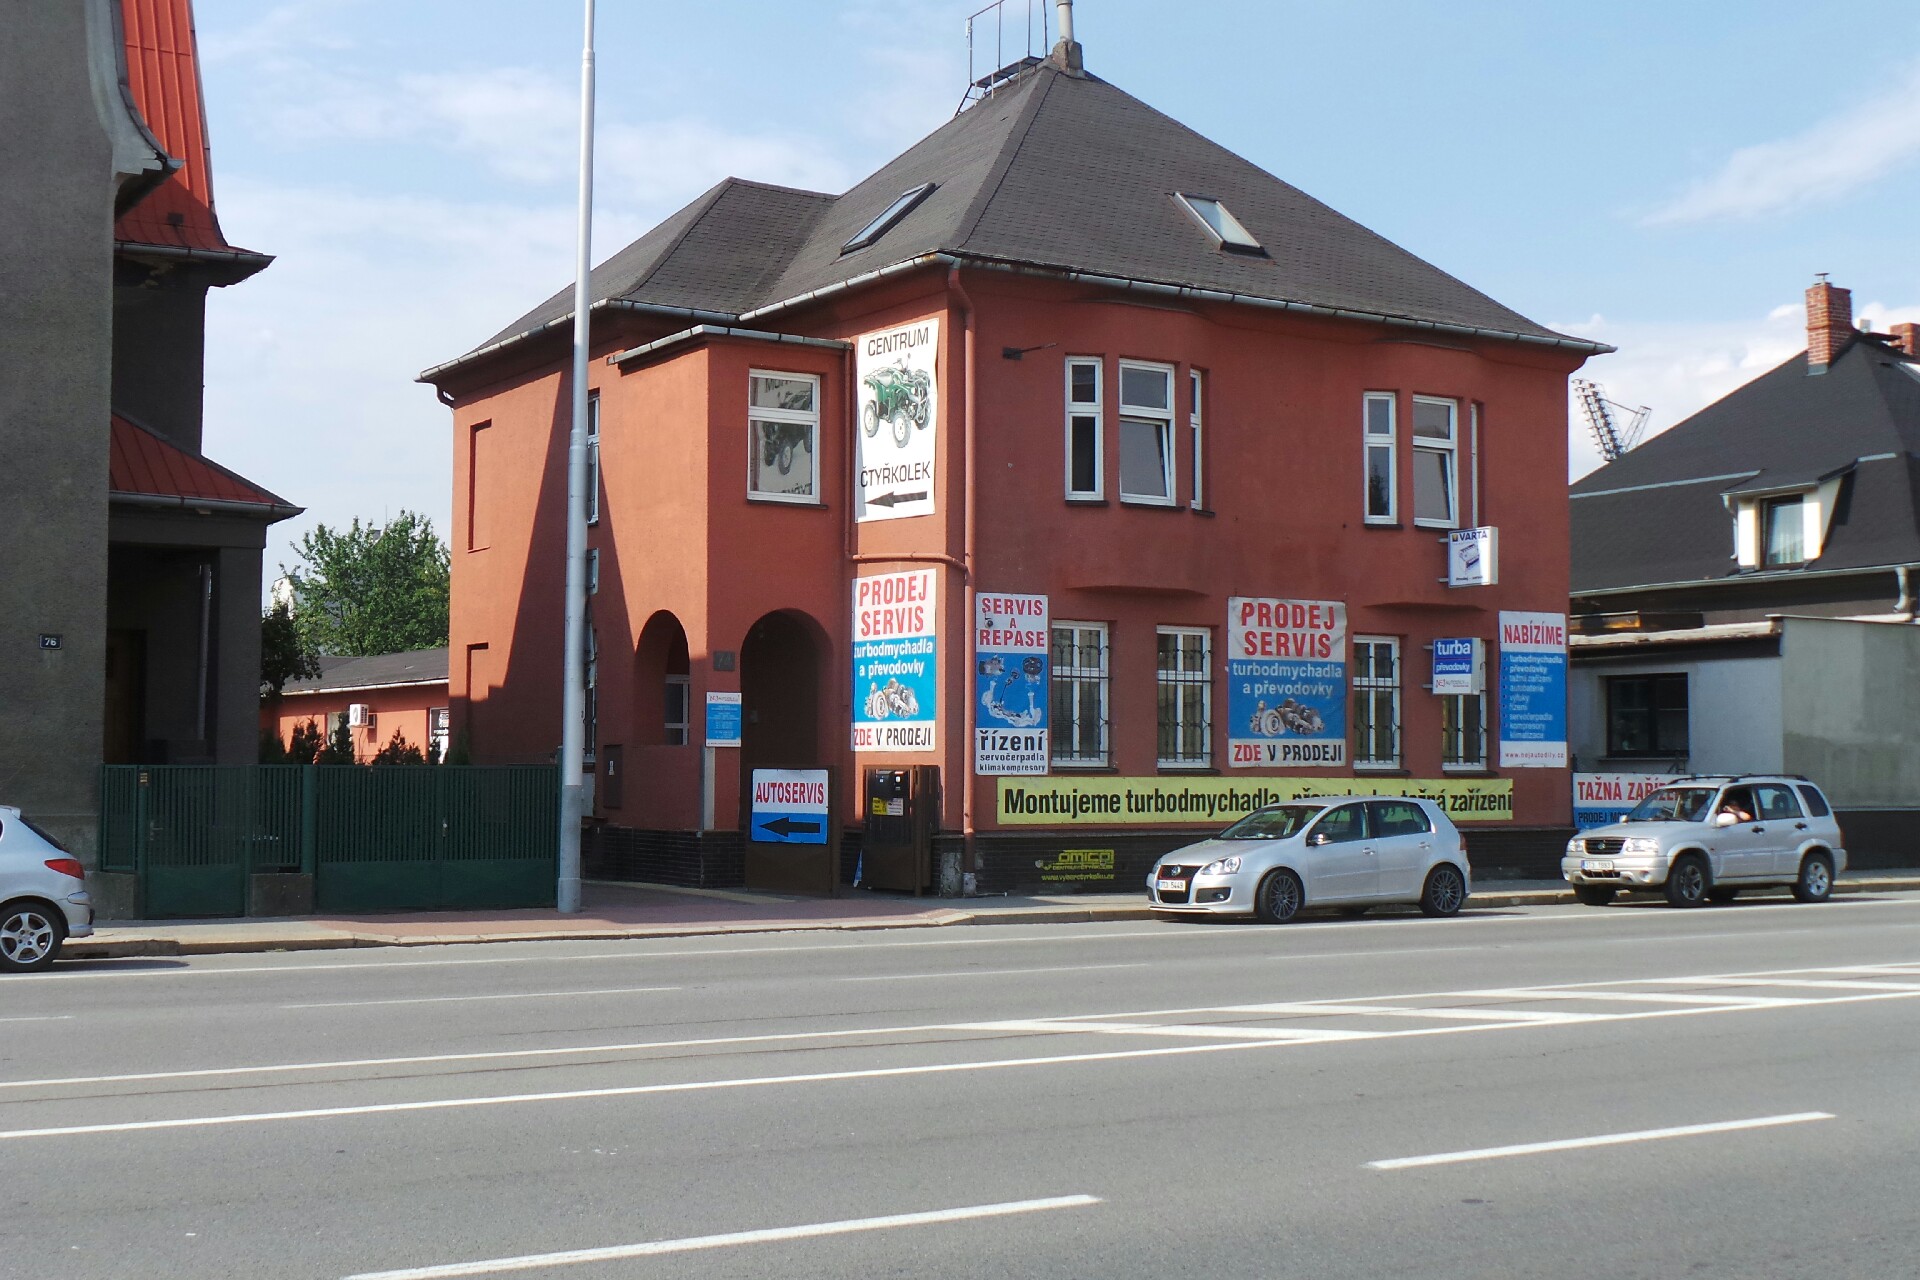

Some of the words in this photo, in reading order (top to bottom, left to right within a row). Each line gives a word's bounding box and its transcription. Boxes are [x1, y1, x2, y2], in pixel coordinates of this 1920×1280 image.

[867, 327, 929, 357] CENTRUM
[860, 461, 931, 488] ČTYŘKOLEK
[1459, 531, 1487, 541] VARTA
[859, 574, 928, 607] PRODEJ
[981, 598, 1043, 616] SERVIS
[1241, 602, 1335, 630] PRODEJ
[860, 605, 924, 637] SERVIS
[1009, 617, 1017, 629] A
[44, 637, 57, 646] 76
[979, 629, 1045, 648] REPASE
[1504, 620, 1563, 646] NABÍZÍME
[1244, 631, 1331, 659] SERVIS
[1436, 639, 1471, 655] turba
[859, 663, 865, 677] a
[868, 659, 925, 680] převodovky
[1232, 662, 1343, 681] turbodmychadla
[1435, 662, 1470, 673] převodovky
[1242, 683, 1251, 694] a
[1254, 680, 1333, 698] převodovky
[854, 728, 872, 746] ZDE
[876, 728, 883, 746] V
[886, 727, 931, 746] PRODEJI
[979, 730, 1045, 751] řízení
[980, 752, 1045, 763] servočerpadla
[1233, 744, 1262, 762] ZDE
[1266, 744, 1276, 762] V
[1282, 744, 1342, 762] PRODEJI
[979, 763, 1045, 773] klimakompresory
[755, 782, 824, 804] AUTOSERVIS
[1577, 776, 1622, 801] TAŽNÁ
[1004, 788, 1121, 819] Montujeme
[1125, 788, 1280, 817] turbodmychadla
[1450, 788, 1514, 812] zařízení
[1578, 811, 1607, 824] PRODEJ
